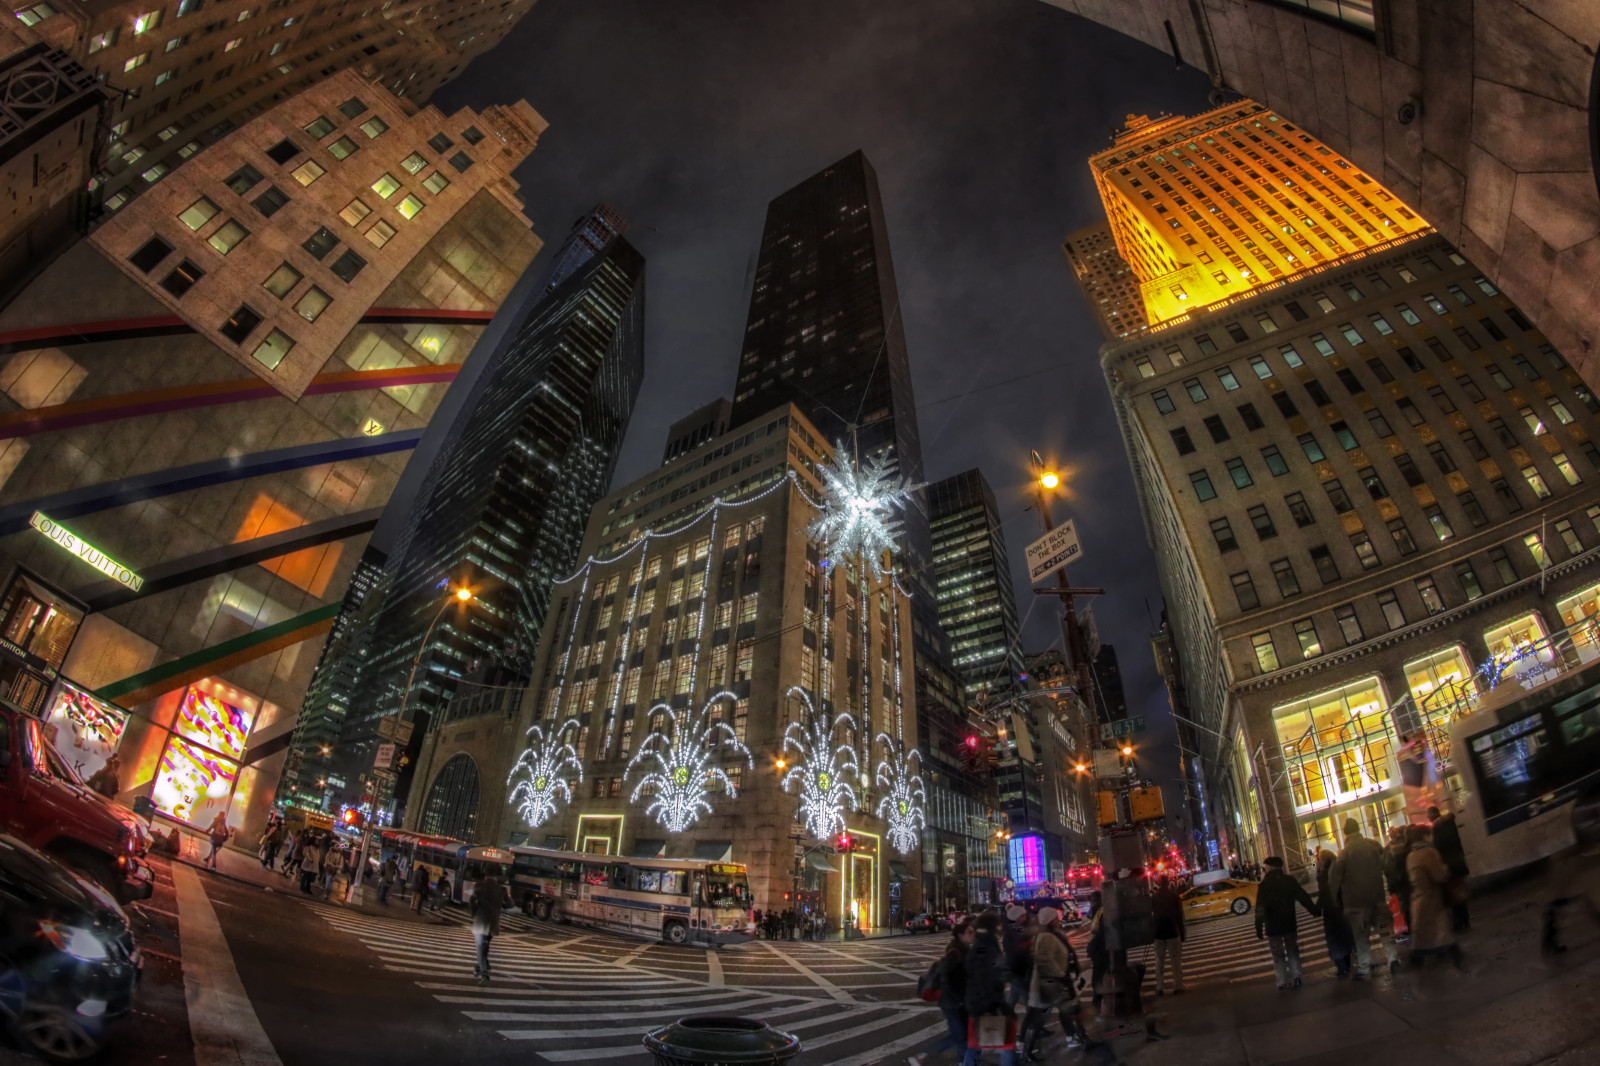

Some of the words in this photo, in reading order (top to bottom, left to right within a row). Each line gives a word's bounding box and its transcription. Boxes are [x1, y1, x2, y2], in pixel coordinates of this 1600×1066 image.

[1049, 526, 1071, 543] BLOCK
[31, 512, 76, 549] LOUIS
[79, 542, 143, 591] VUITTON
[1038, 547, 1051, 559] THE
[1051, 538, 1066, 551] BOX
[1056, 544, 1078, 562] POINTS
[1113, 722, 1122, 735] W
[1125, 720, 1135, 733] 57
